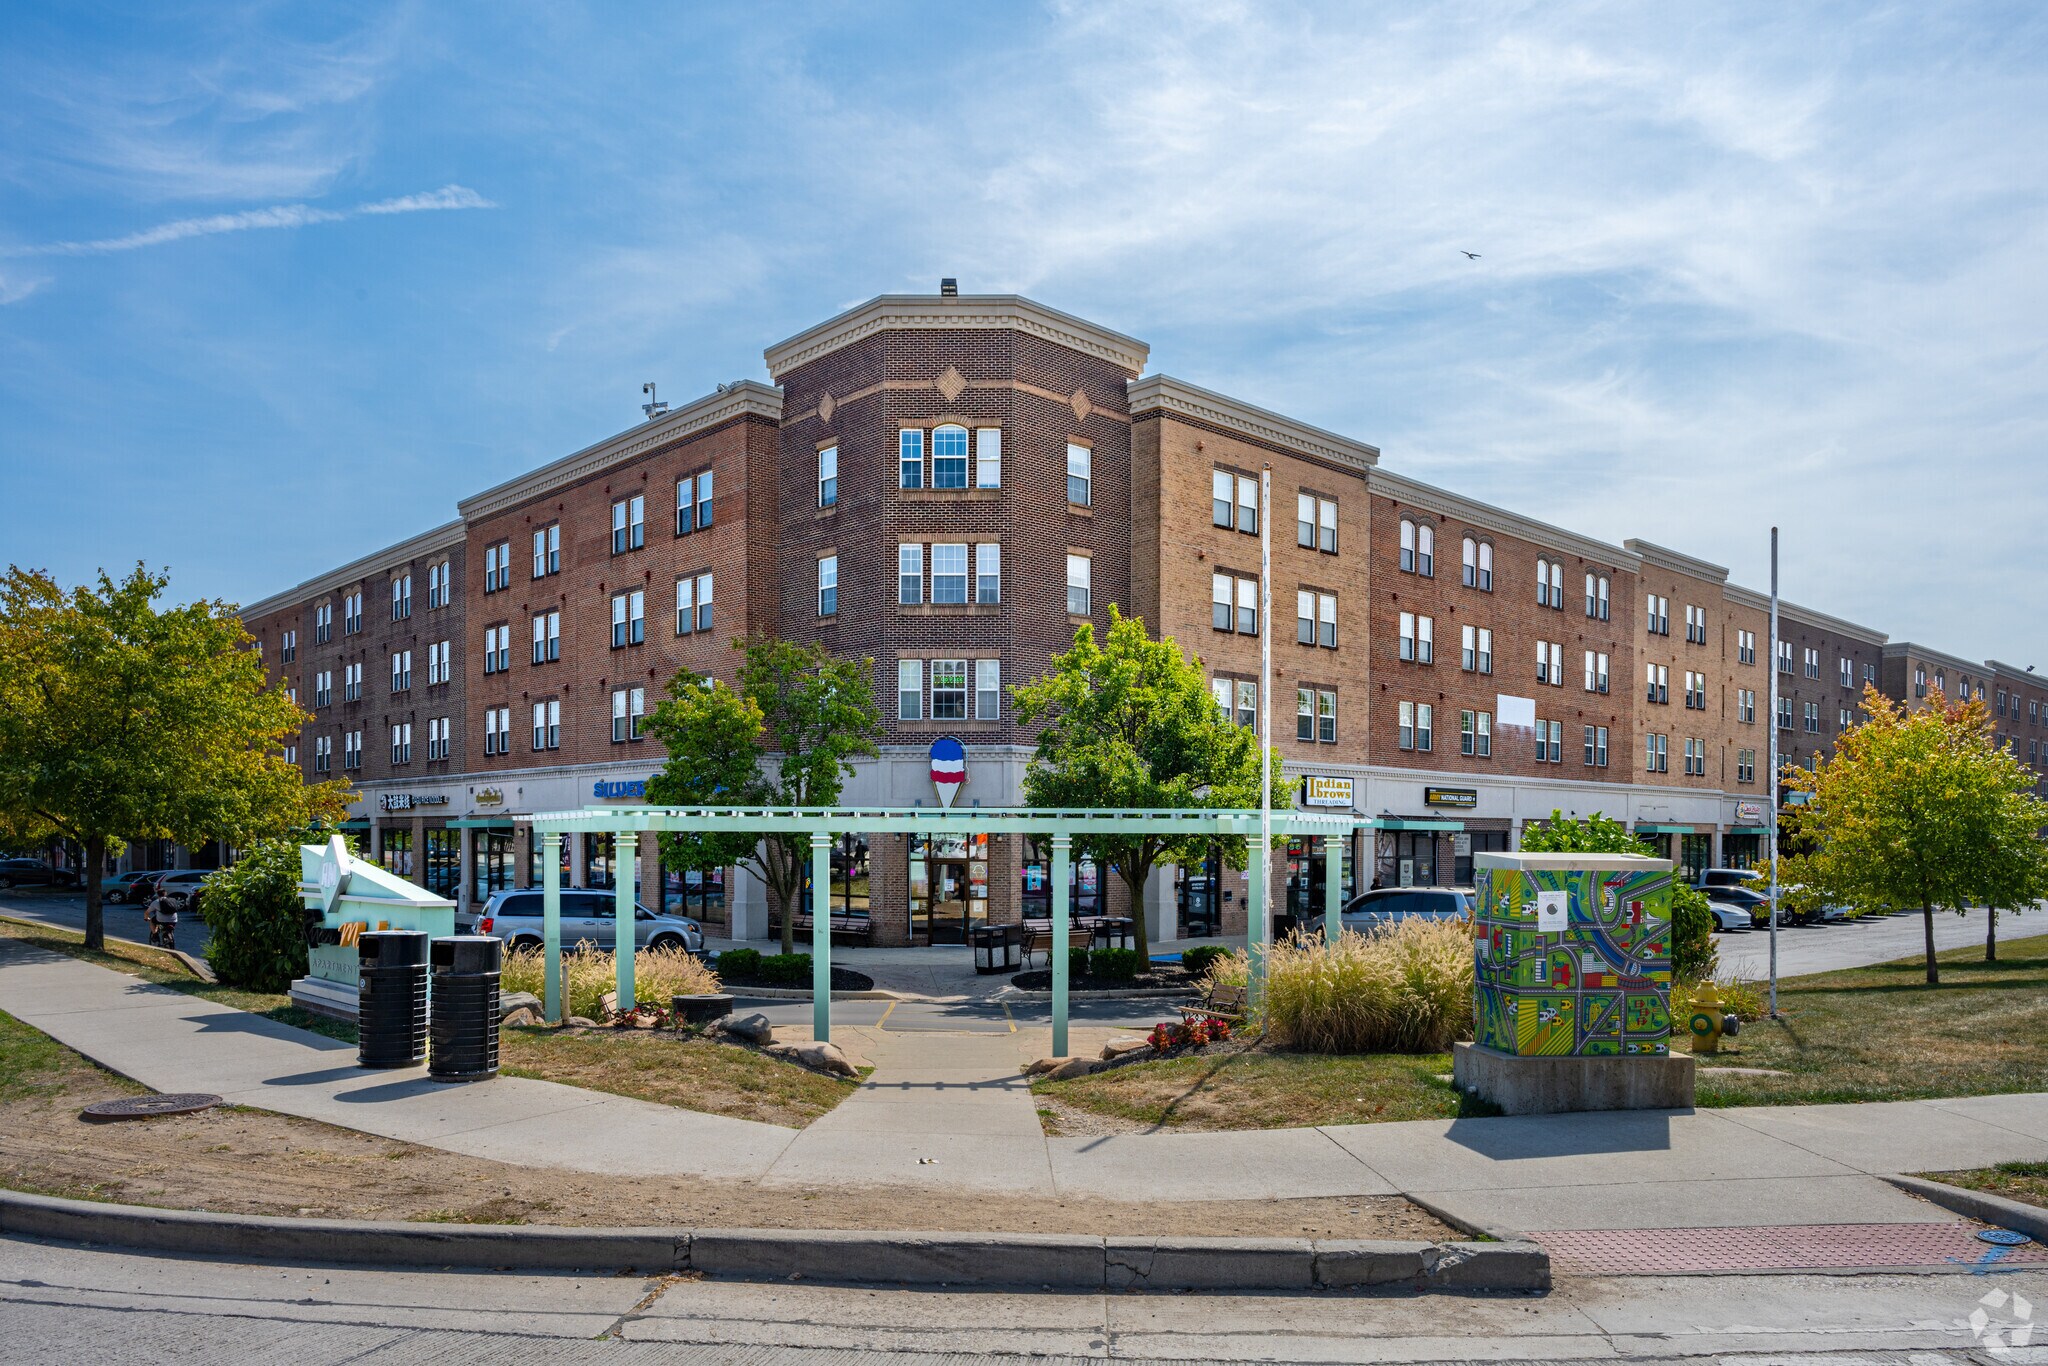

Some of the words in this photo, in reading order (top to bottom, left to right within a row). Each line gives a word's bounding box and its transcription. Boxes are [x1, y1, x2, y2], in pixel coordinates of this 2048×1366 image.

[1308, 778, 1351, 798] Indian
[1317, 789, 1351, 799] brows
[312, 958, 359, 975] APARTMENT
